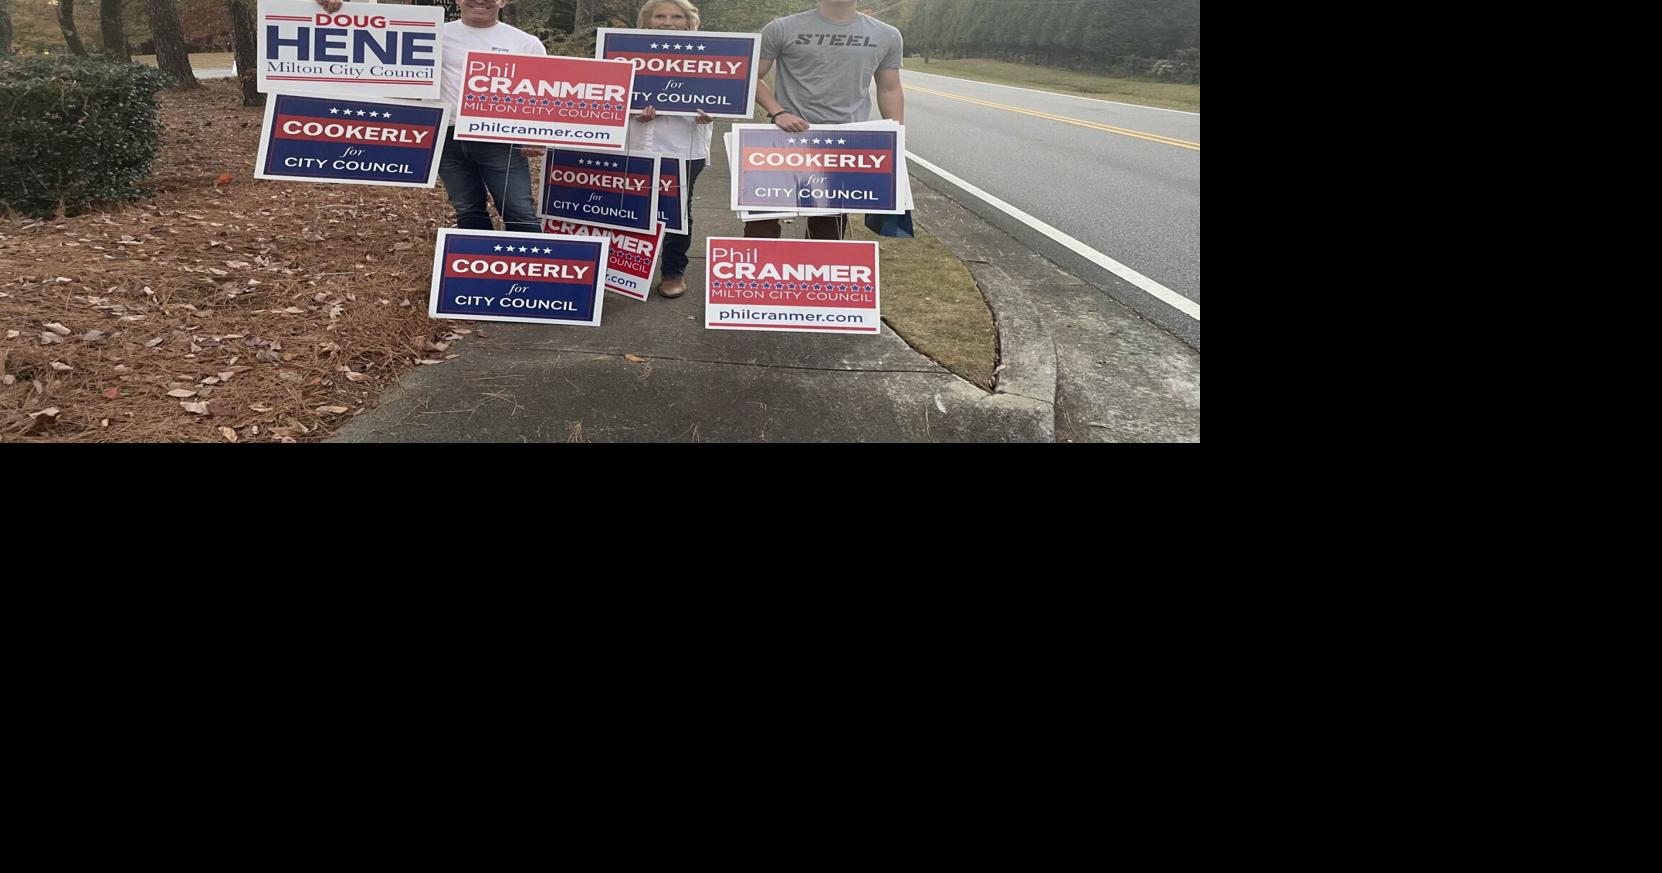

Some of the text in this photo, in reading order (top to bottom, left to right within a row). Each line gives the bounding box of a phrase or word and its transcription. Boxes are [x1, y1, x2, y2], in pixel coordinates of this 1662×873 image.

[316, 14, 386, 28] DOUG
[266, 25, 436, 66] HENE
[795, 34, 877, 47] STEEL
[267, 61, 433, 79] Milton City Council
[469, 61, 516, 78] Phil
[616, 56, 742, 75] OOKERLY
[468, 76, 625, 102] CRANMER
[664, 79, 684, 91] for
[633, 92, 731, 105] TY COUNCIL
[464, 102, 622, 120] MILTON CITY COUNCIL
[283, 120, 429, 143] COOKERLY
[469, 121, 610, 140] philcranmer.com
[343, 146, 365, 157] for
[285, 157, 413, 174] CITY COUNCIL
[748, 152, 886, 168] COOKERLY
[552, 169, 645, 191] COOKERLY
[805, 175, 828, 186] for
[588, 192, 603, 201] for
[755, 188, 878, 201] CITY COUNCIL
[554, 200, 638, 220] CITY COUNCIL
[713, 248, 758, 262] Phil
[452, 259, 589, 279] COOKERLY
[610, 257, 648, 273] OUNCIL
[713, 263, 872, 283] CRANMER
[506, 284, 529, 295] for
[712, 290, 872, 302] MILTON CITY COUNCIL
[455, 296, 577, 311] CITY COUNCIL
[719, 309, 863, 323] philcranmer.com
